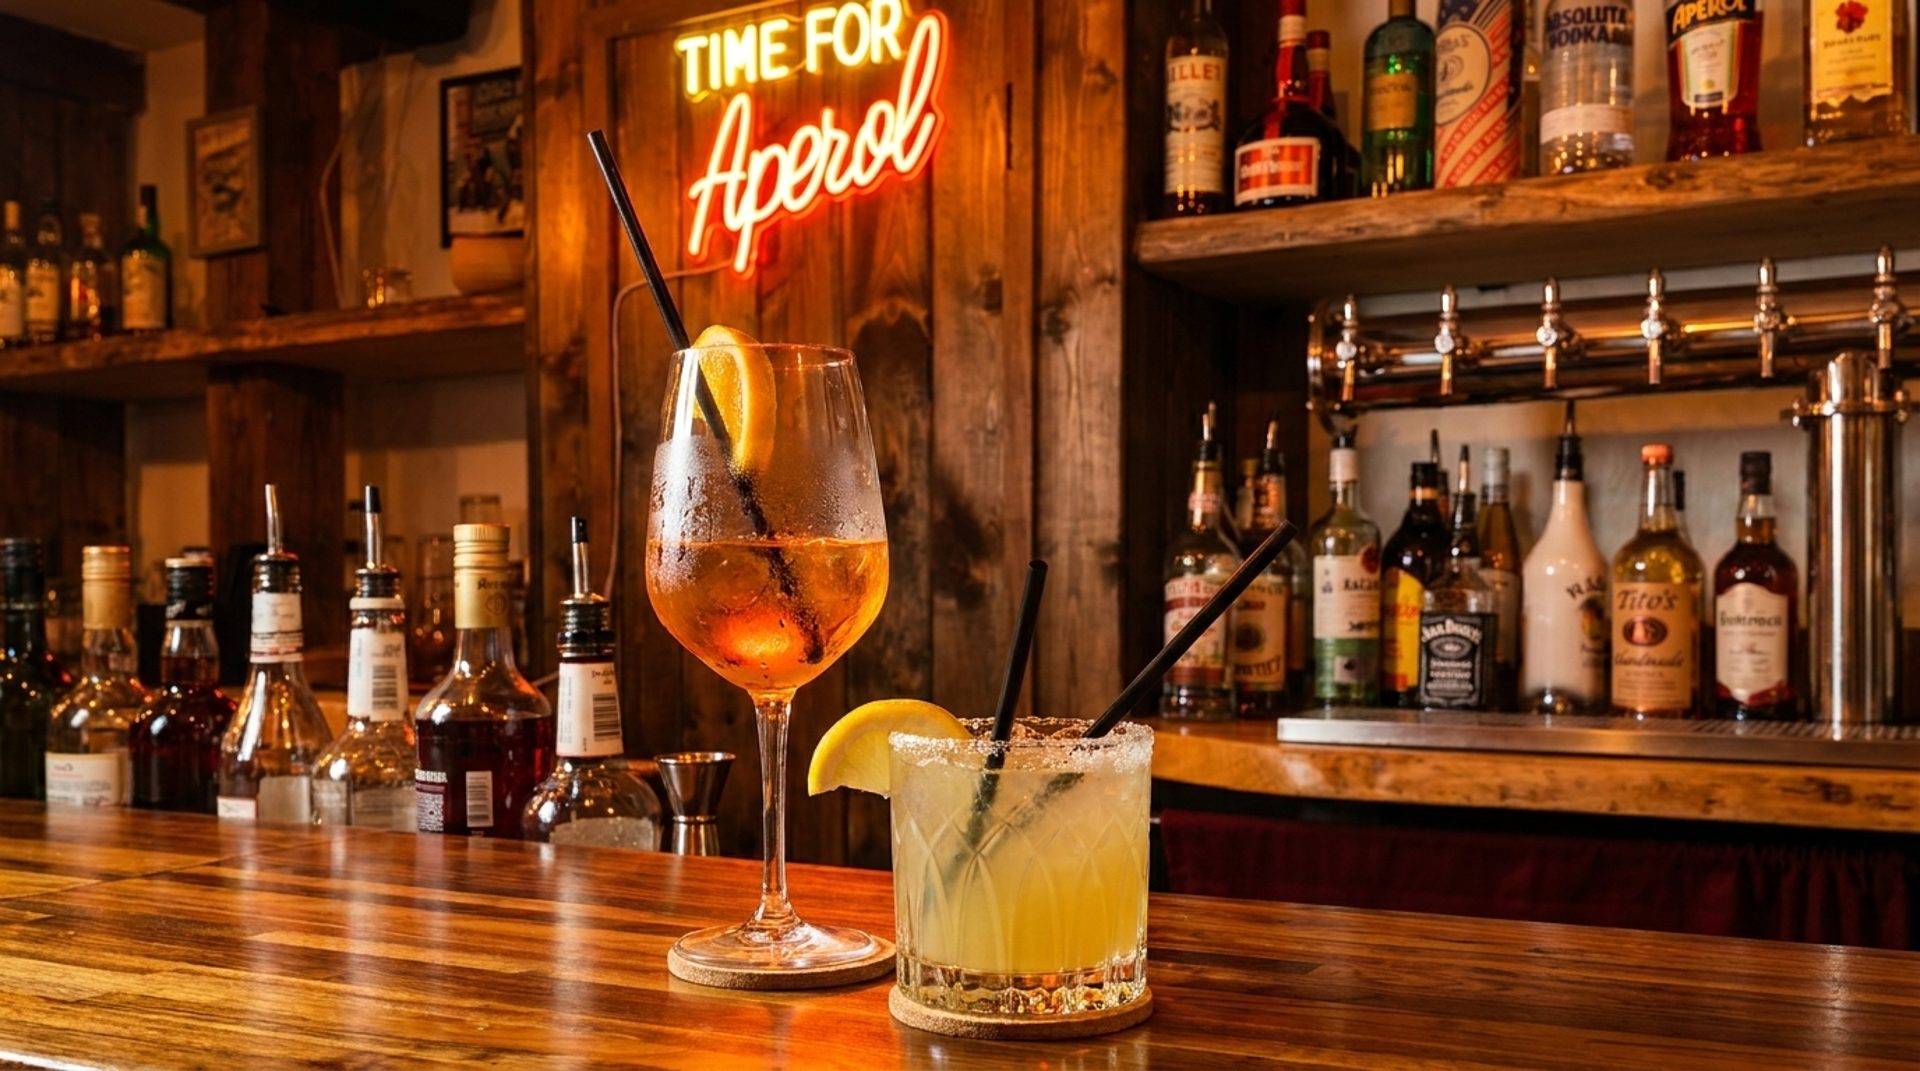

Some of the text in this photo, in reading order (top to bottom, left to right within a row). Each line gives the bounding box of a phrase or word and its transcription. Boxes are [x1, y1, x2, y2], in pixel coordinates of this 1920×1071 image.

[677, 0, 902, 95] TIME FOR
[688, 15, 940, 273] Aperol
[1618, 588, 1677, 611] Tito's
